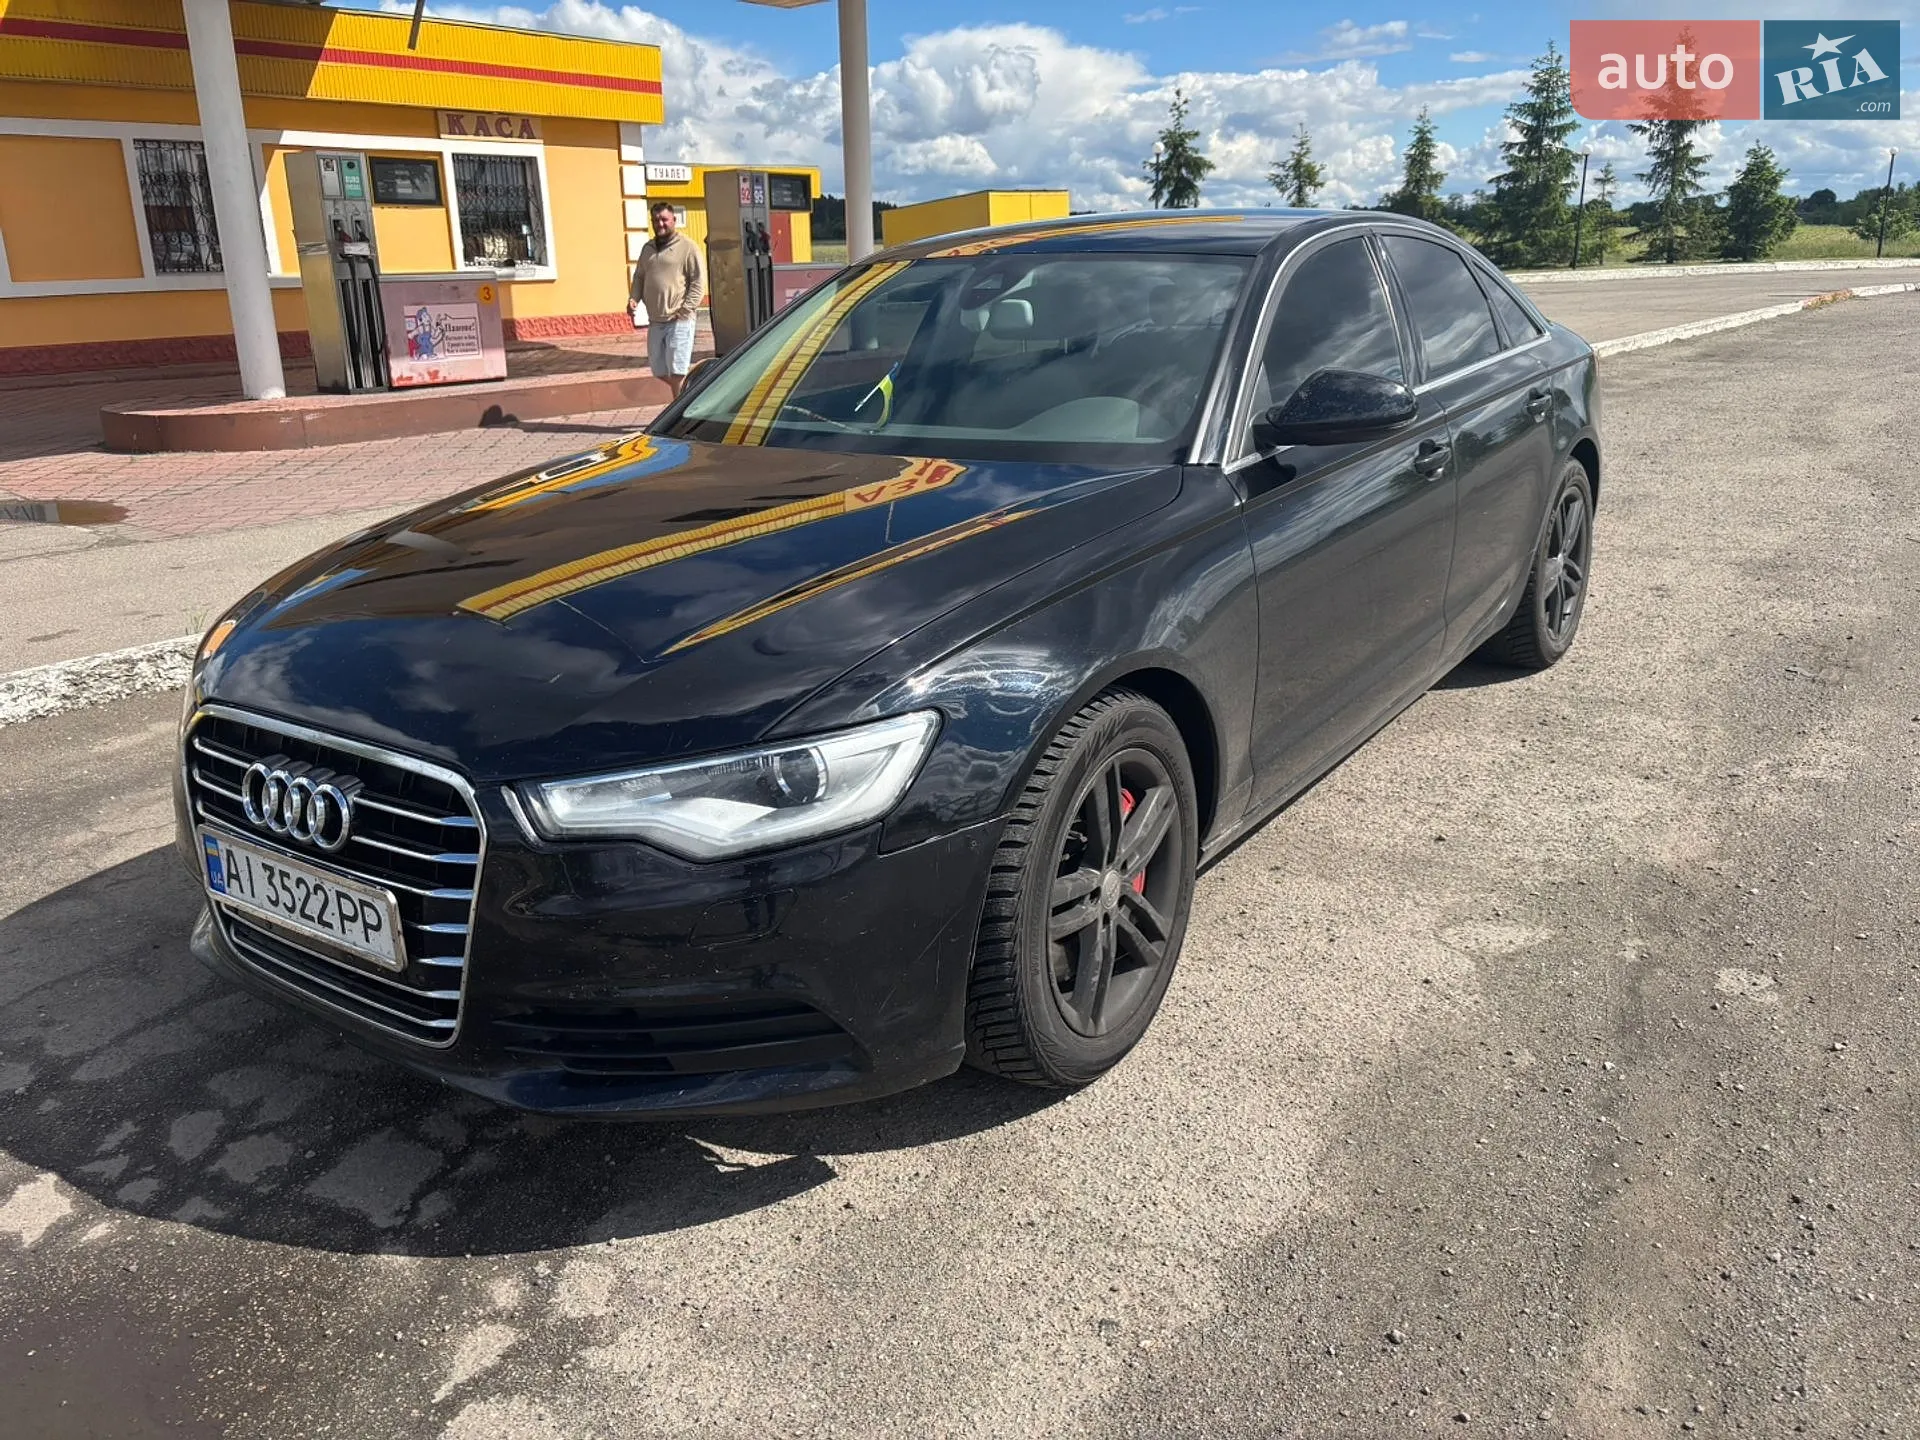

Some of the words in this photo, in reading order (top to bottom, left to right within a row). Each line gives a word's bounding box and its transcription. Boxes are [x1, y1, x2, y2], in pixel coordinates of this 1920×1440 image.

[446, 113, 537, 139] КАСА
[654, 167, 686, 179] ТУАЛЕТ
[753, 189, 764, 204] 95
[482, 286, 492, 301] 3
[226, 849, 256, 898] AI
